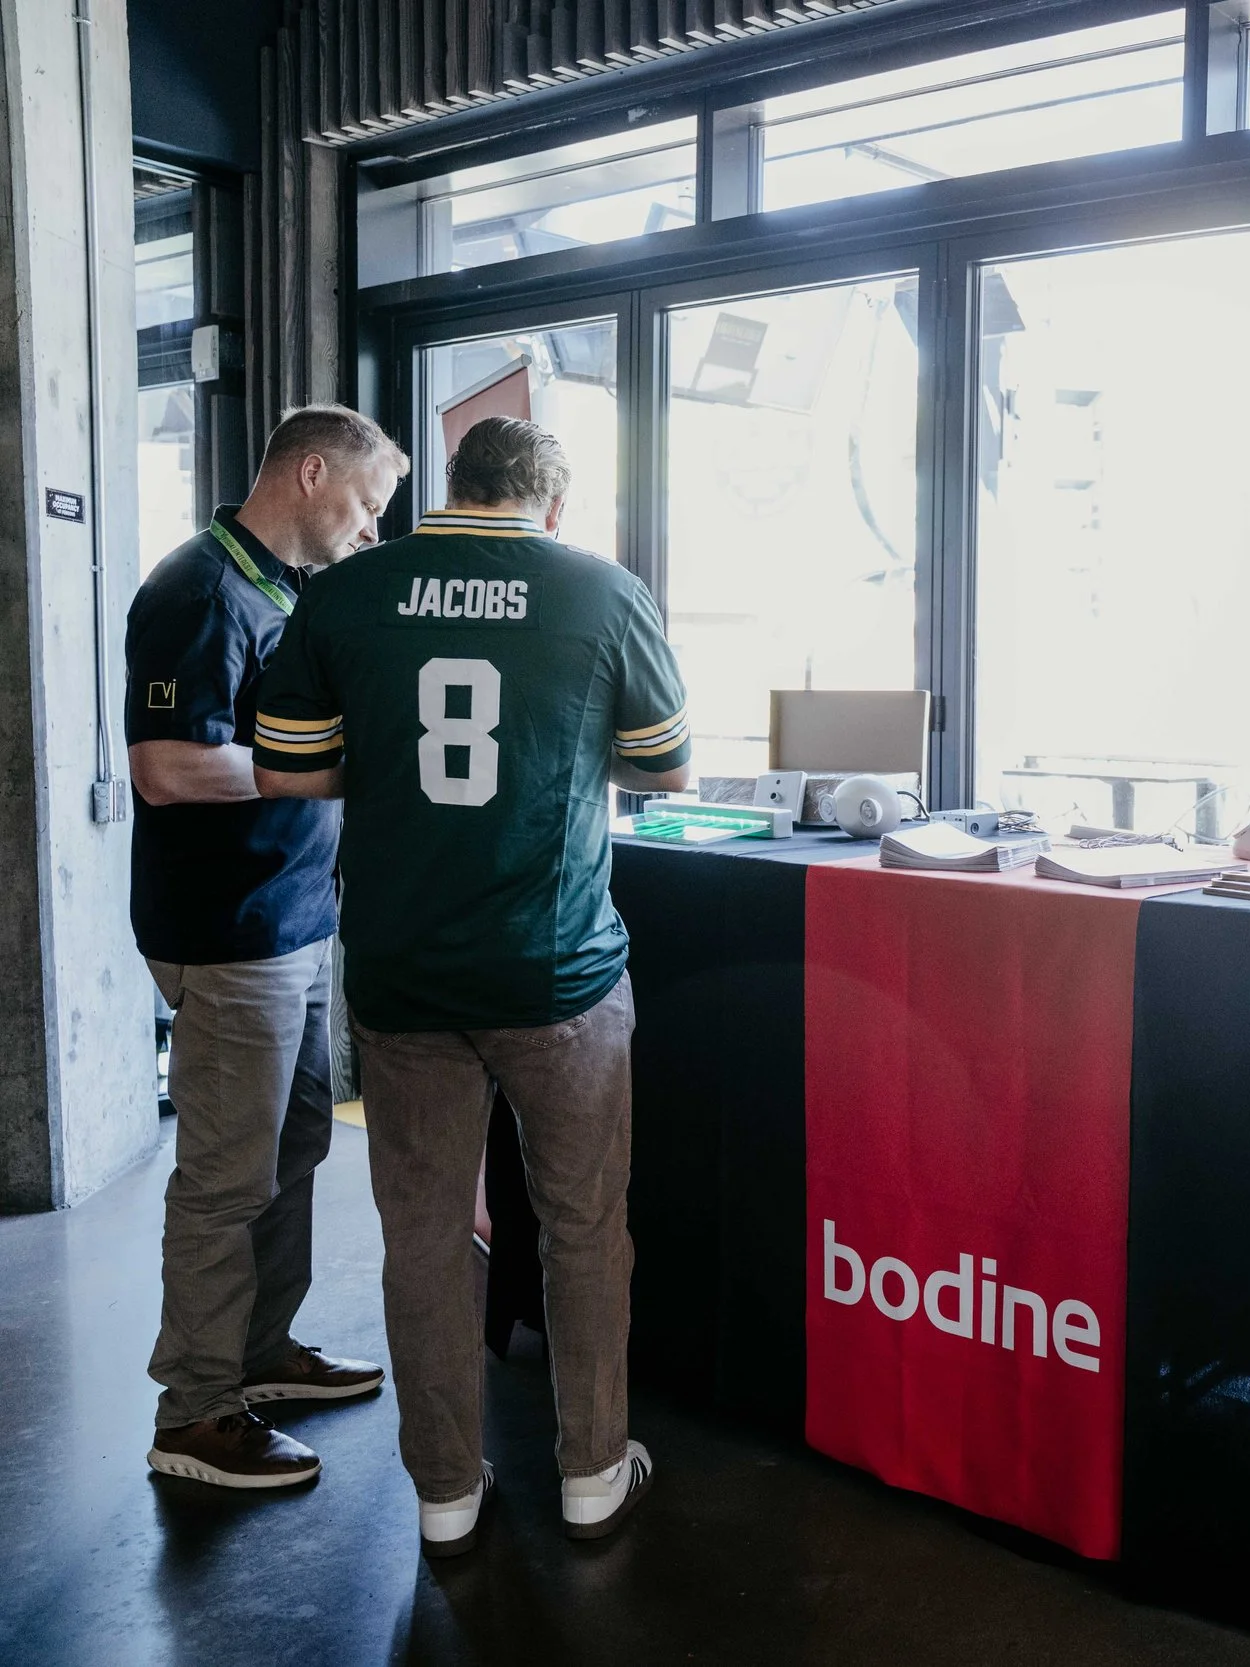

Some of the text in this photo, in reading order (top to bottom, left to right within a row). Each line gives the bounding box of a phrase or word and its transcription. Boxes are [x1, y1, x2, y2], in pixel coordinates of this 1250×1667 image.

[398, 577, 528, 620] JACOBS
[418, 658, 501, 807] 8
[823, 1218, 1101, 1373] bodine
